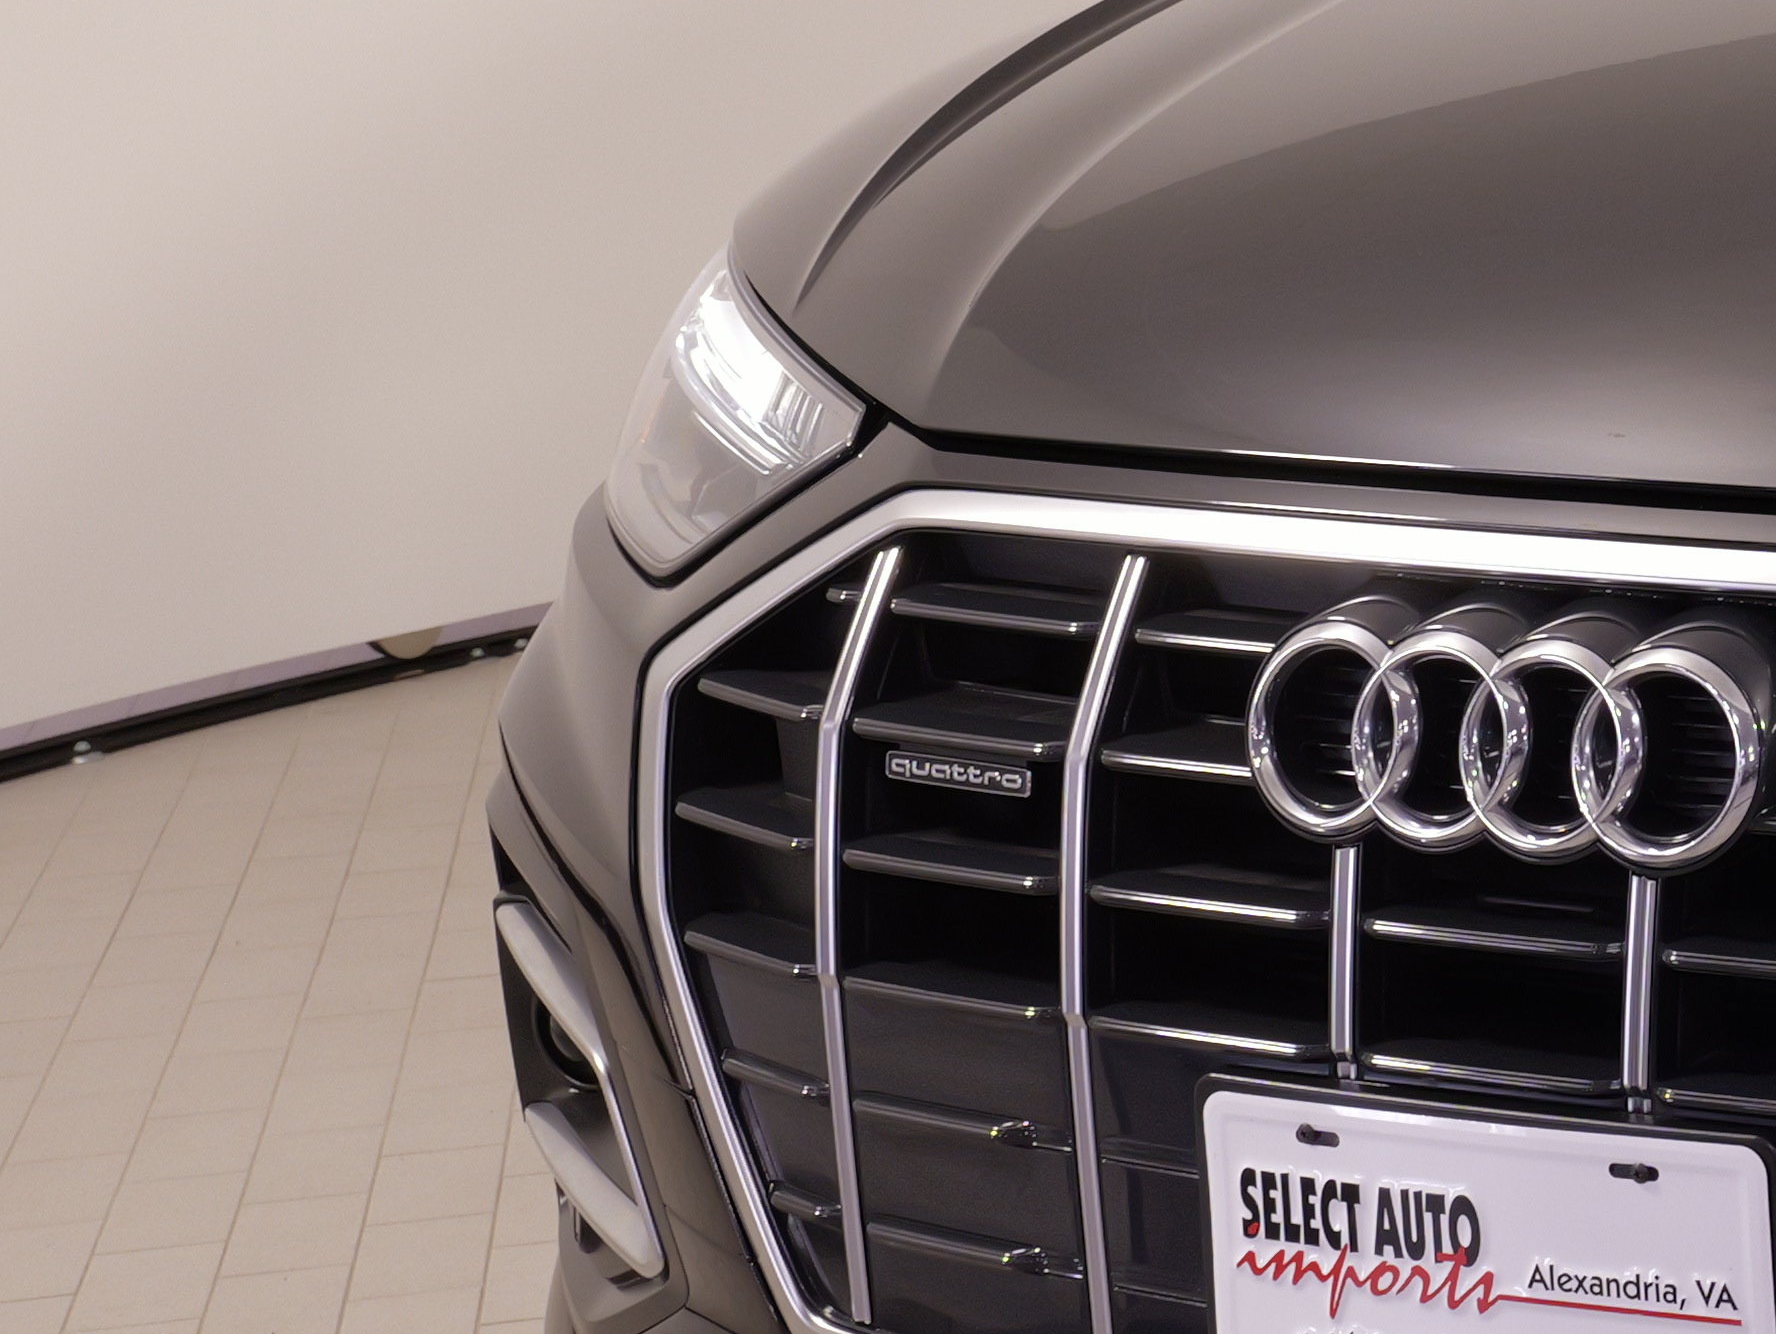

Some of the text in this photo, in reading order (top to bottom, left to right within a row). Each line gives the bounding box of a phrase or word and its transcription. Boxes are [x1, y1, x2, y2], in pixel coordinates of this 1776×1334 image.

[890, 757, 1023, 790] quattro
[1239, 1166, 1482, 1268] SELECT AUTO
[1236, 1242, 1503, 1320] imports
[1527, 1263, 1739, 1311] Alexandria, VA
